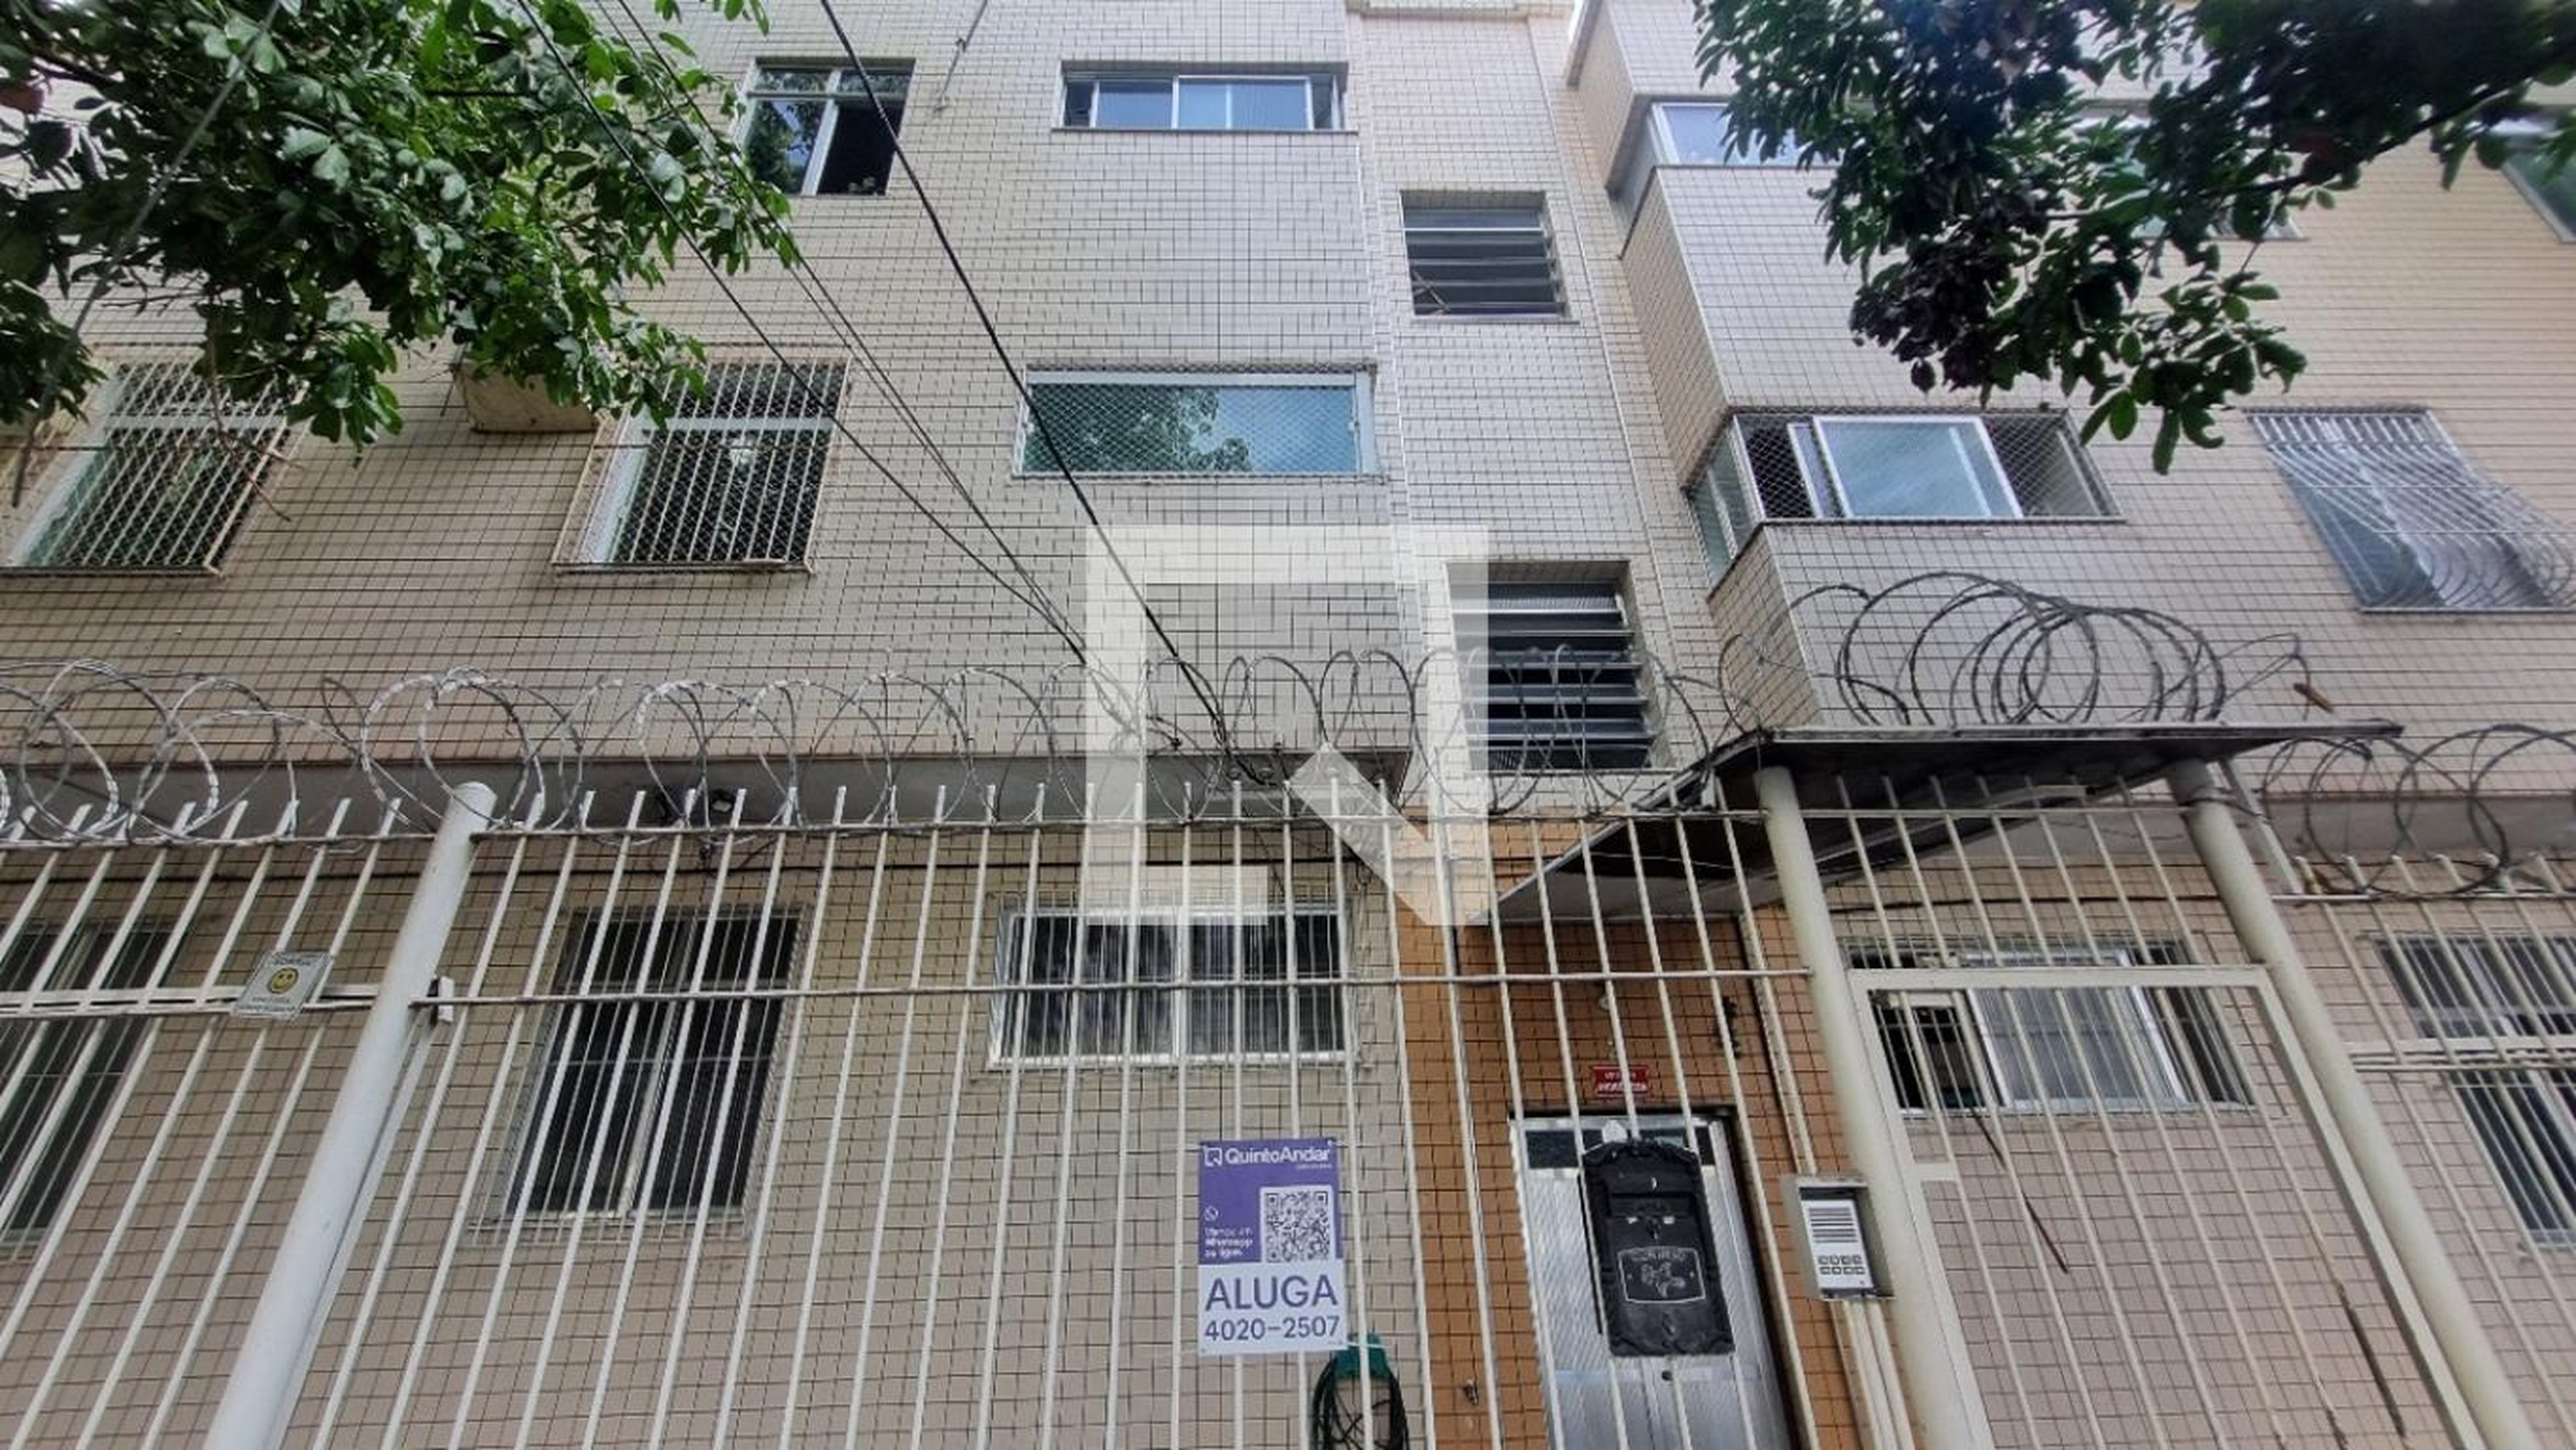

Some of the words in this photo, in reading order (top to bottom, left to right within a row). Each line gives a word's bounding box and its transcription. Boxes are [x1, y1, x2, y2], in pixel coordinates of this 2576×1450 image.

[1225, 1146, 1331, 1164] QuintoAndar
[1205, 1274, 1338, 1311] ALUGA
[1203, 1315, 1340, 1341] 4020-2507
